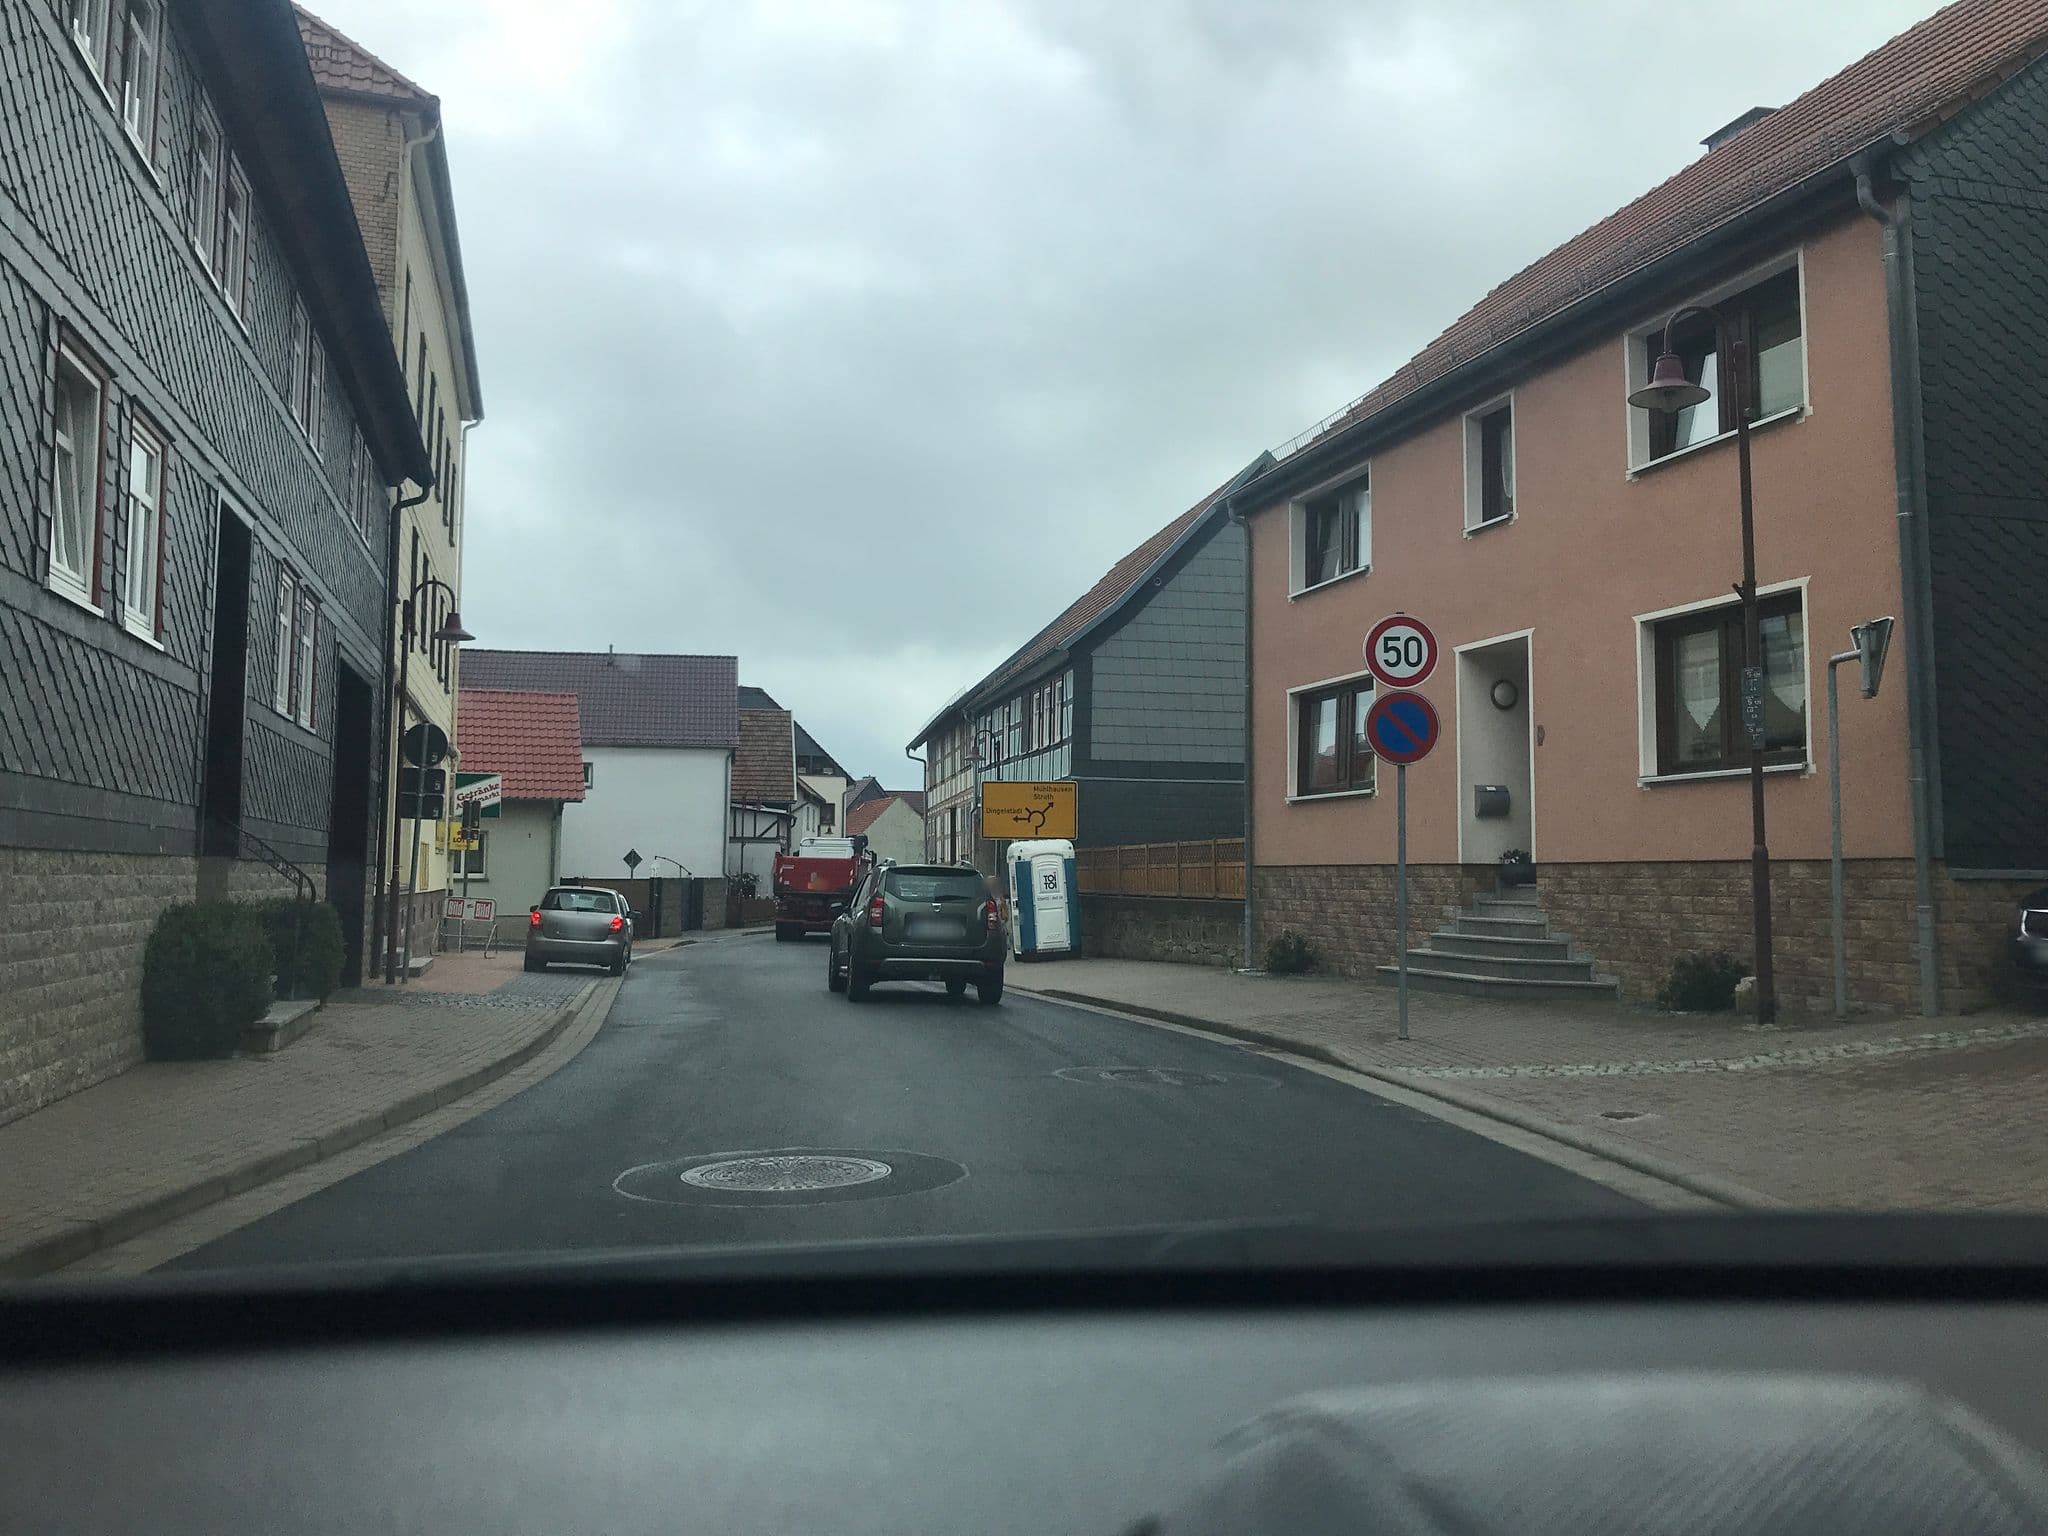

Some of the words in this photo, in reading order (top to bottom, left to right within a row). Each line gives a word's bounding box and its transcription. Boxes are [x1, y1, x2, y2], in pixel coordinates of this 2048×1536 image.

[1383, 635, 1423, 668] 50
[456, 783, 500, 802] Getränke
[1033, 785, 1073, 793] Mühlhausen
[455, 791, 501, 810] Amarkt
[986, 807, 1023, 815] Dingelstädt
[448, 901, 464, 916] Bild
[476, 903, 490, 917] Bild
